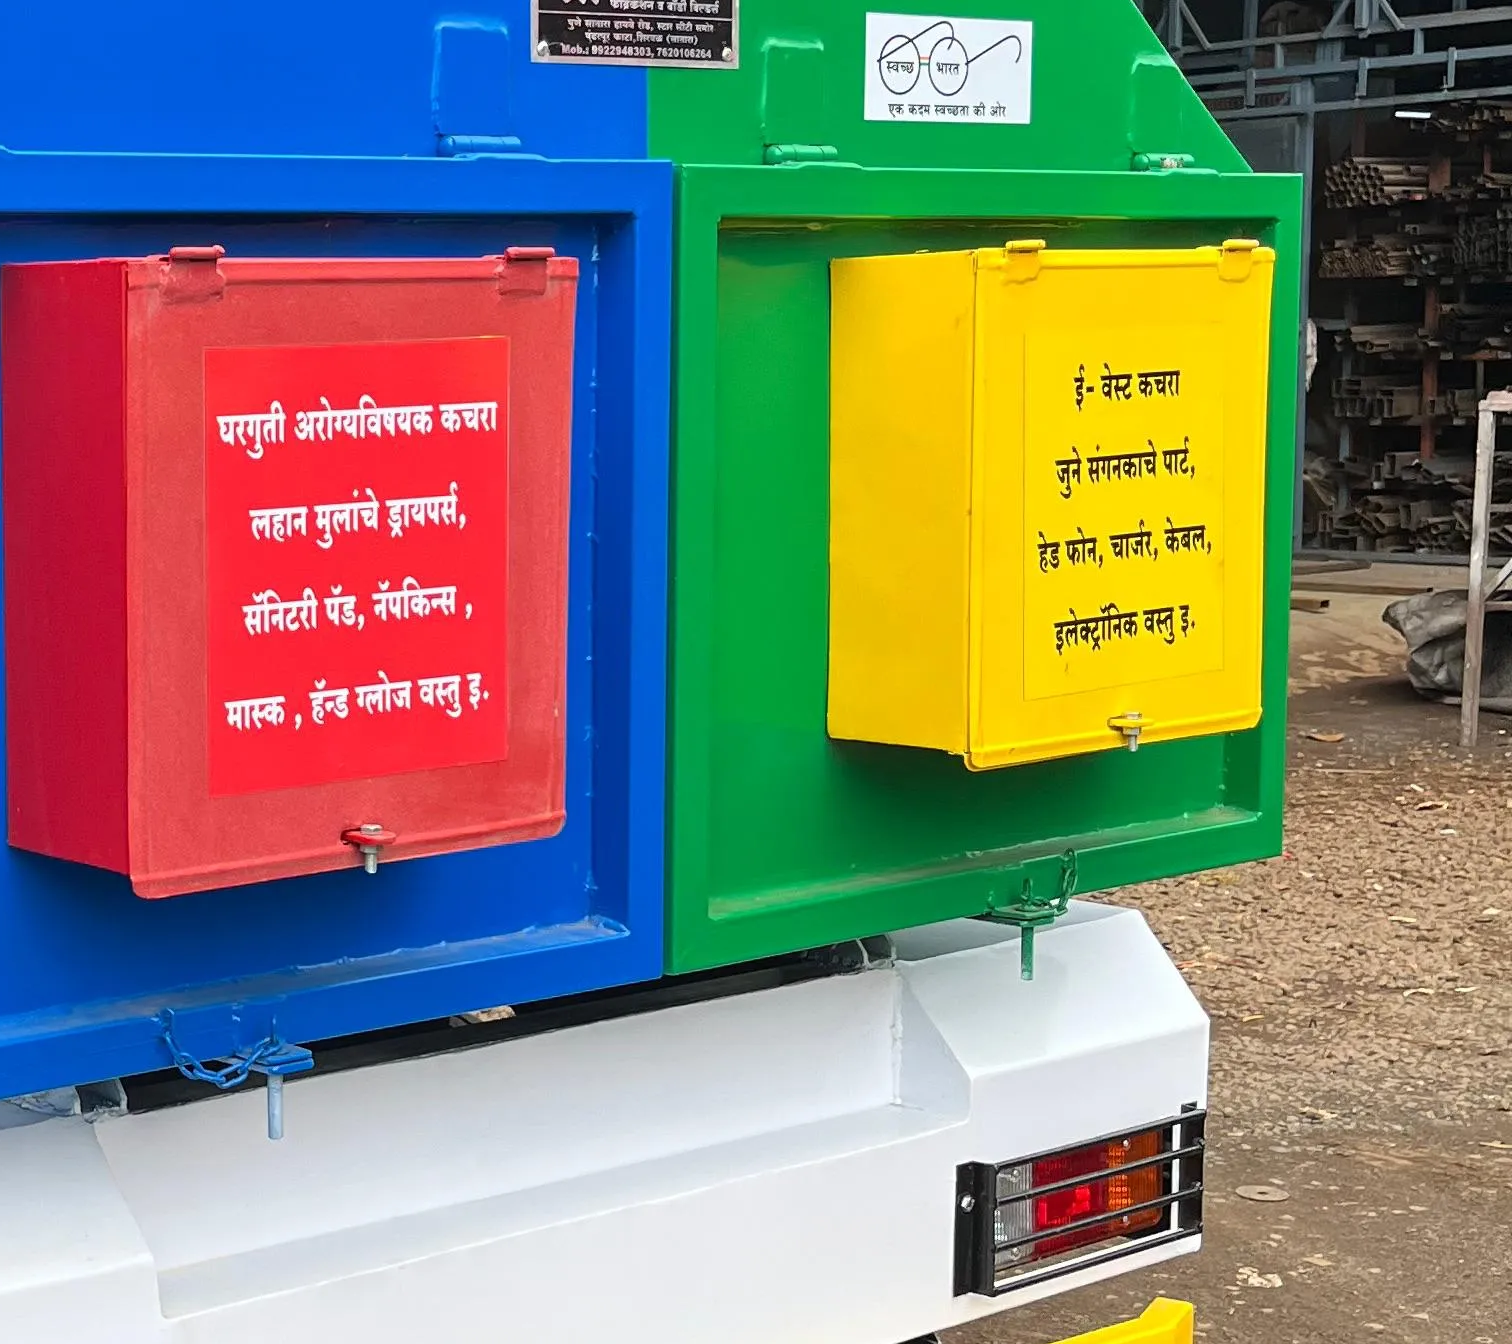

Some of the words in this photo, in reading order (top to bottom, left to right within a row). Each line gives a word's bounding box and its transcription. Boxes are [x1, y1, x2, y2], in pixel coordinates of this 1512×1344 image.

[886, 61, 914, 74] स्वच्छ
[936, 62, 960, 75] भारत
[888, 103, 904, 117] एक
[908, 104, 931, 117] कदम
[934, 104, 969, 117] स्वच्छता
[973, 102, 986, 116] की
[1100, 362, 1133, 402] वेस्ट
[1138, 369, 1181, 398] कचरा
[216, 400, 287, 459] घरगुती
[439, 401, 498, 432] कचरा
[1055, 445, 1081, 499] जुने
[249, 506, 308, 542] लहान
[314, 487, 379, 549] मुलांचे
[1037, 530, 1061, 574] हेड
[418, 674, 463, 719] वस्तु
